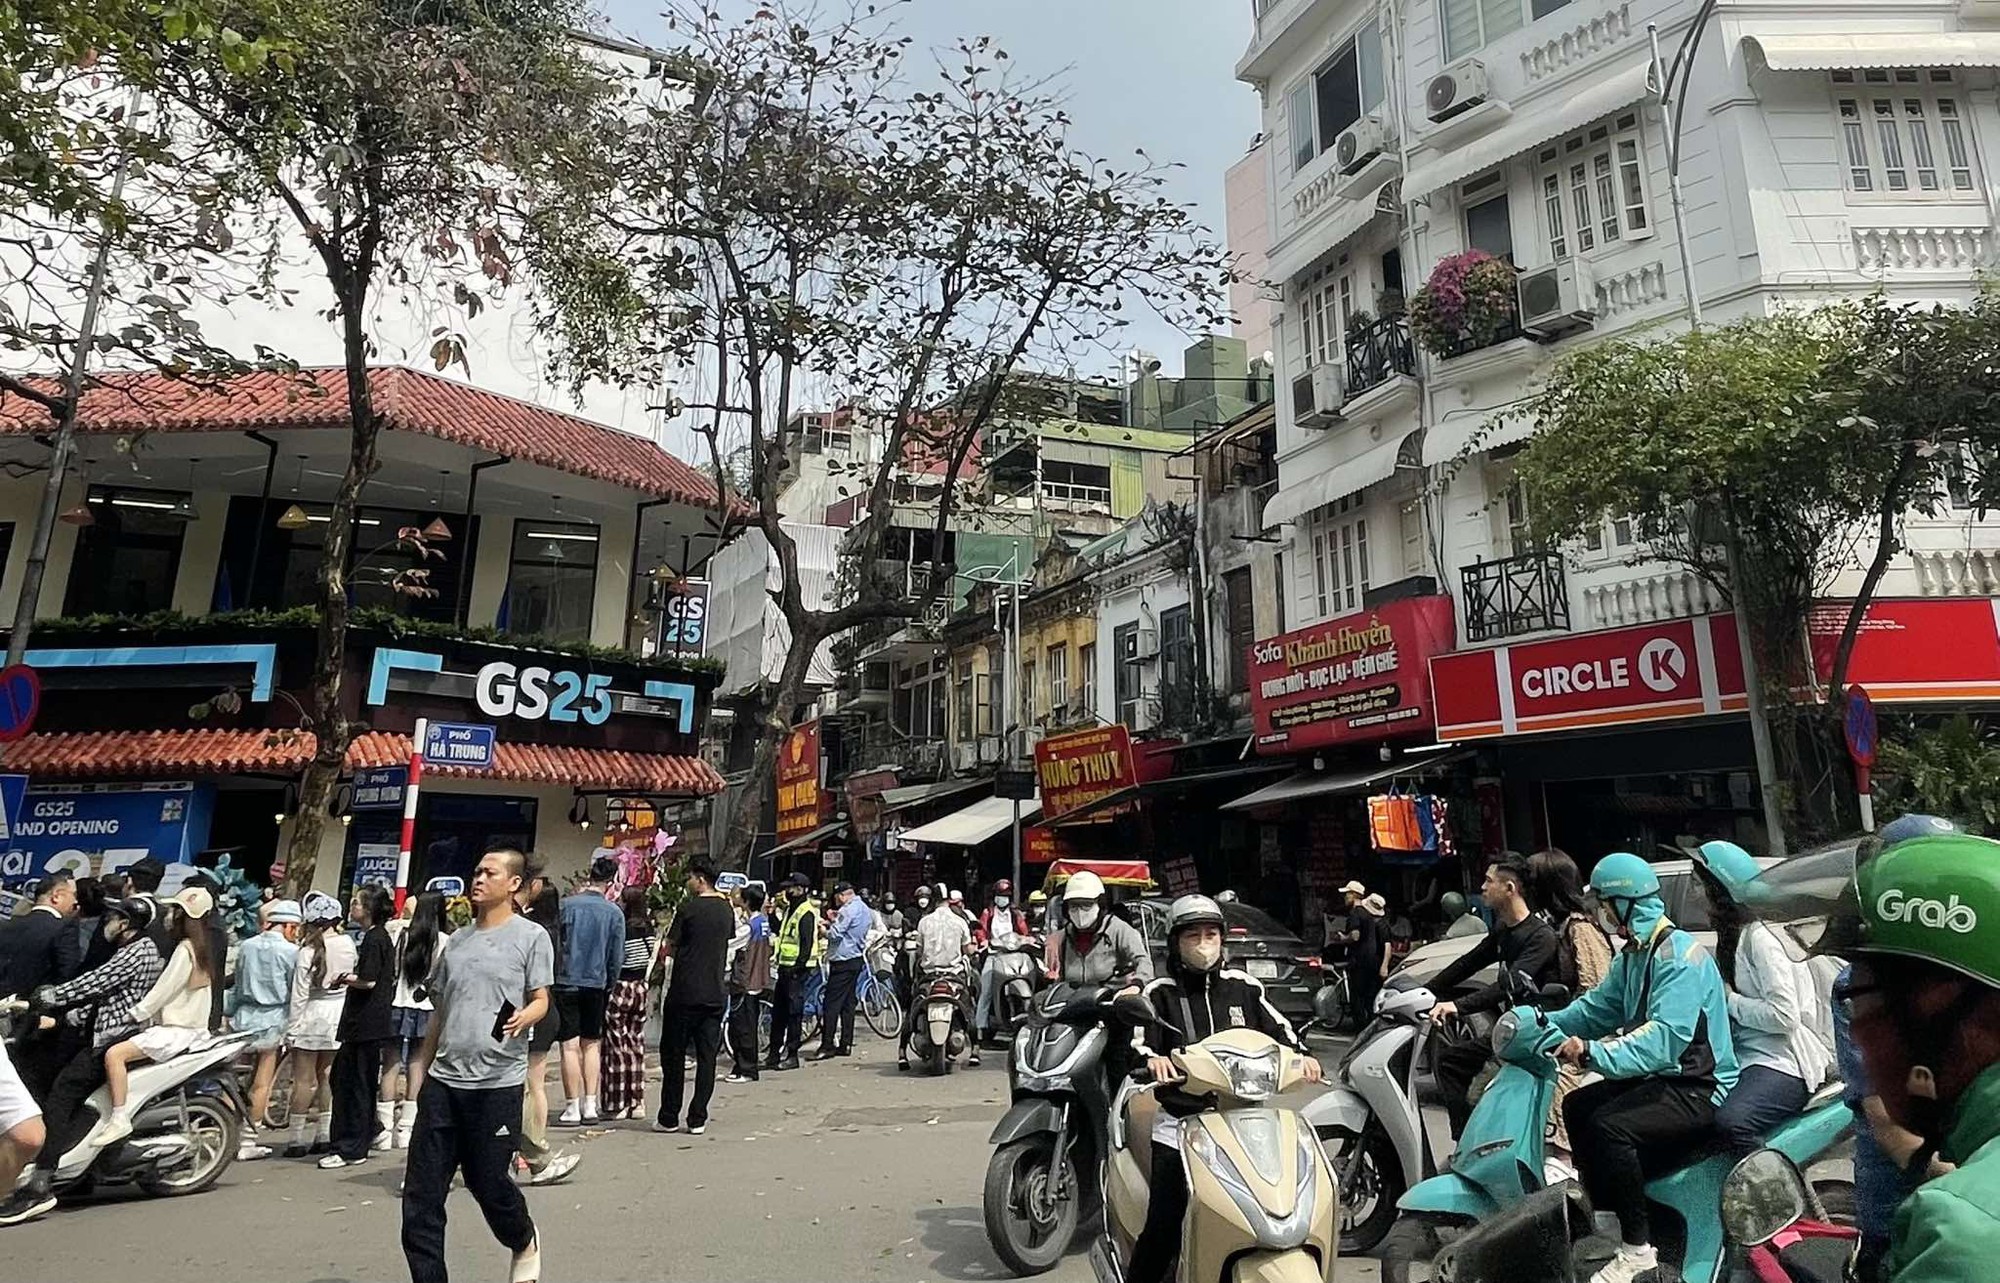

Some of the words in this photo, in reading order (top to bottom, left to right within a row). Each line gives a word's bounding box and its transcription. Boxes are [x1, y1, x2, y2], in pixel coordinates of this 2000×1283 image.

[667, 595, 704, 620] GS
[665, 618, 702, 644] 25
[1253, 641, 1283, 665] Sofa
[1284, 632, 1337, 668] Khánh
[1338, 614, 1393, 655] Huyền
[1309, 667, 1329, 690] BỌC
[1329, 662, 1347, 686] LẠI
[1521, 657, 1630, 698] CIRCLE
[1642, 642, 1686, 690] K
[475, 661, 613, 726] GS25
[449, 744, 487, 760] TRUNG
[34, 801, 76, 817] GS25
[14, 821, 46, 836] AND
[48, 820, 119, 836] OPENING
[1876, 889, 1977, 934] Grab
